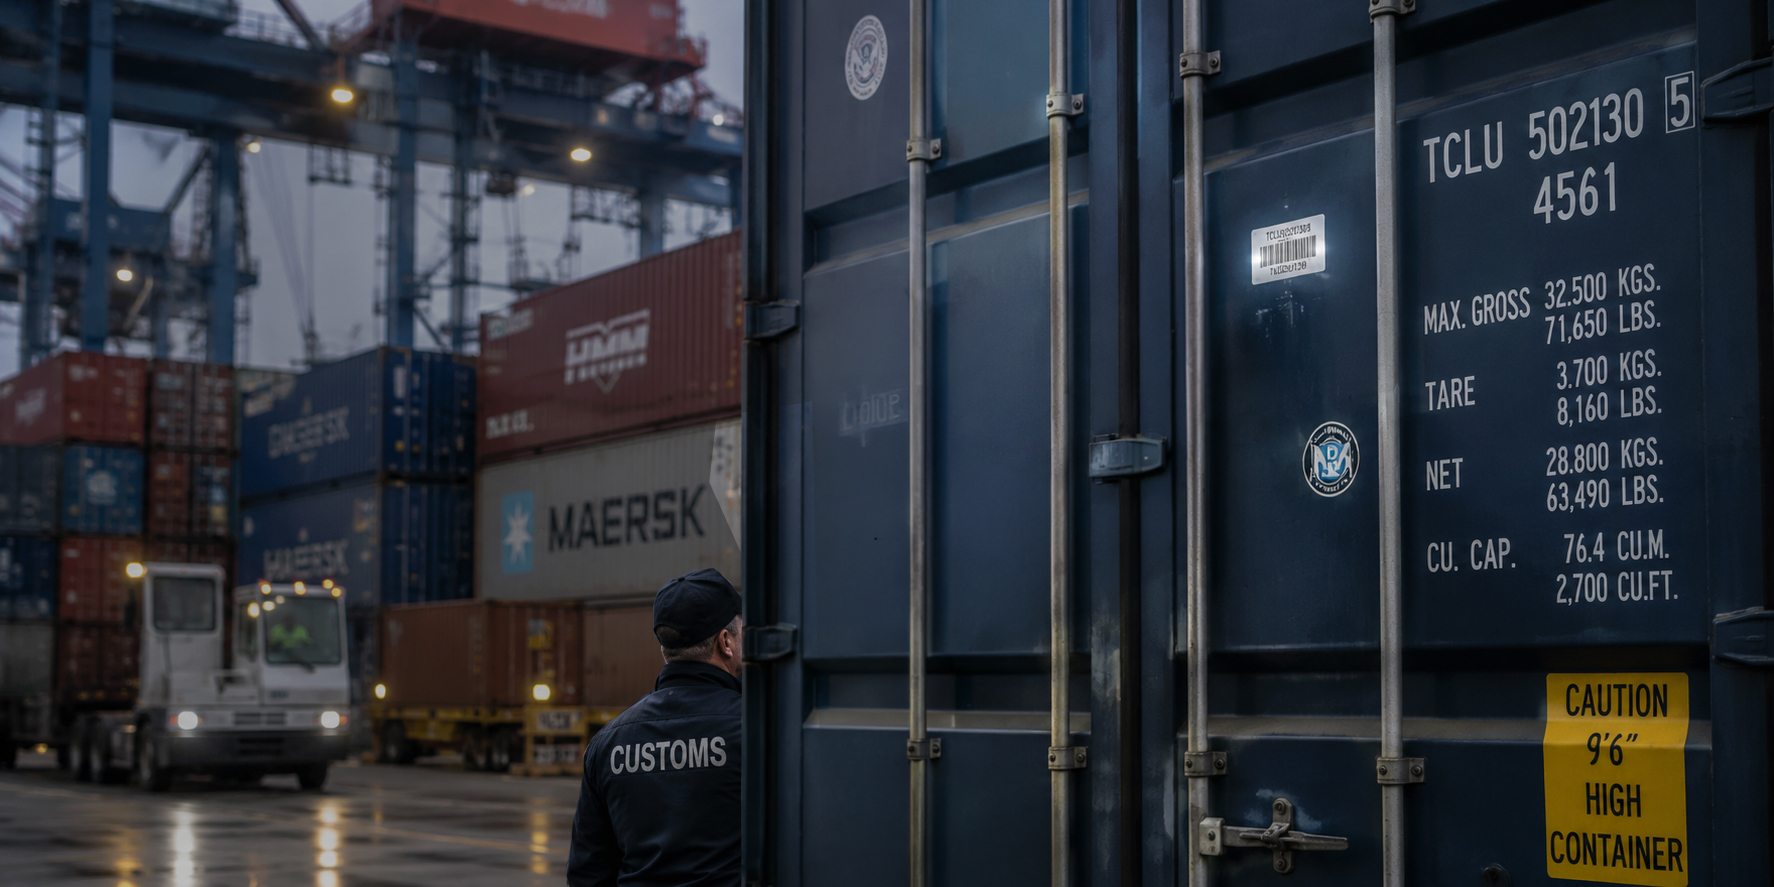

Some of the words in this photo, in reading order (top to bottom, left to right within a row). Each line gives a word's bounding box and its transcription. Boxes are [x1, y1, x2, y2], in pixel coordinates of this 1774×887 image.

[1423, 121, 1504, 184] TCLU
[1529, 88, 1644, 160] 502130
[1669, 75, 1691, 129] 5
[1533, 161, 1616, 225] 4561
[1424, 300, 1466, 334] MAX.
[1472, 287, 1530, 326] GROSS
[1545, 272, 1606, 309] 32.500
[1619, 263, 1660, 296] KGS.
[1545, 308, 1607, 344] 71,650
[1619, 300, 1660, 333] LBS.
[1425, 376, 1475, 411] TARE
[1557, 356, 1607, 390] 3.700
[1620, 349, 1661, 381] KGS.
[1558, 392, 1608, 427] 8,160
[1621, 386, 1661, 417] LBS.
[1427, 458, 1463, 490] NET
[1546, 442, 1608, 476] 28.800
[1621, 437, 1663, 468] KGS.
[1547, 479, 1609, 512] 63,490
[1622, 475, 1663, 505] LBS.
[548, 488, 706, 554] MAERSK
[1428, 542, 1458, 572] CU.
[1471, 538, 1515, 570] CAP.
[1564, 532, 1604, 563] 76.4
[1618, 529, 1669, 560] CU.M.
[1557, 573, 1607, 605] 2,700
[1618, 571, 1677, 601] CU.FT.
[1566, 682, 1669, 717] CAUTION
[610, 736, 727, 775] CUSTOMS
[1585, 781, 1643, 819] HIGH
[1549, 830, 1685, 873] CONTAINER
